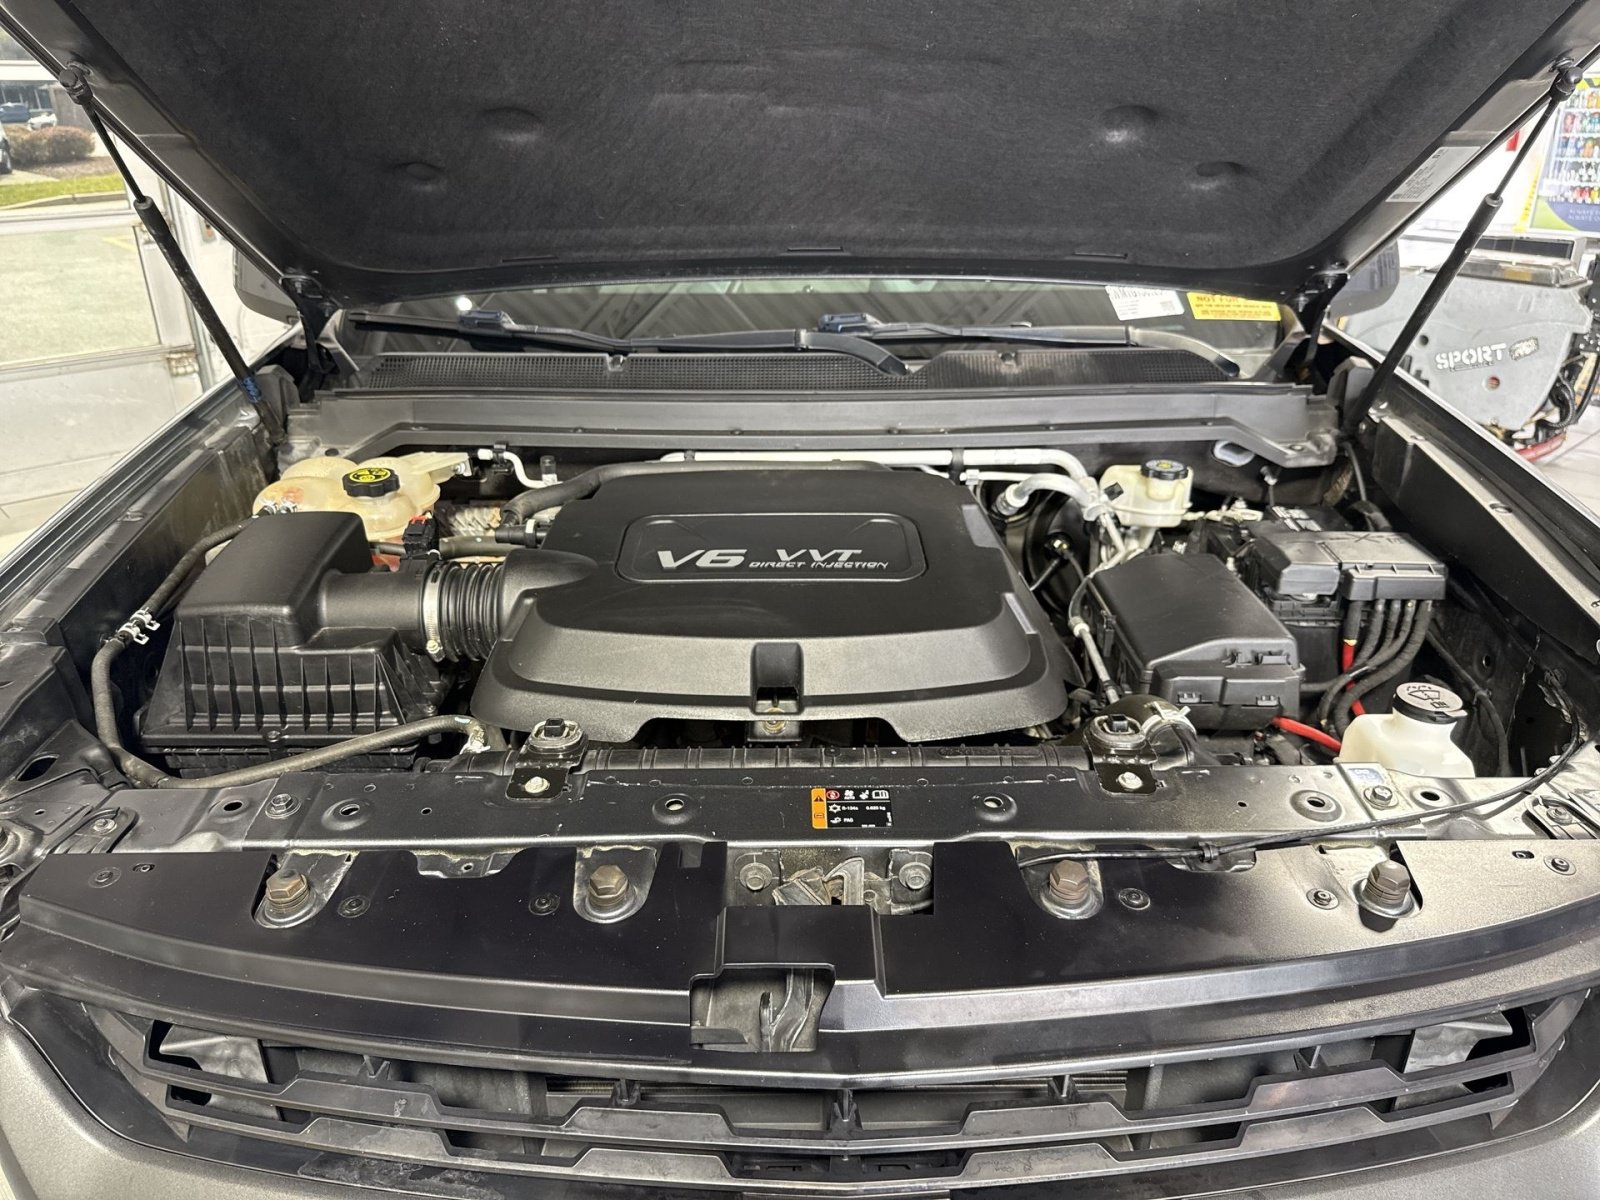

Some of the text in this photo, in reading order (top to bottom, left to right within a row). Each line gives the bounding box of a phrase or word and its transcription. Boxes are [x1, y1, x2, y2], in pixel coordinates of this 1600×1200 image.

[1435, 343, 1507, 370] SPORT
[657, 548, 863, 569] V6 VVT
[748, 561, 889, 570] DIRECT INJECTION
